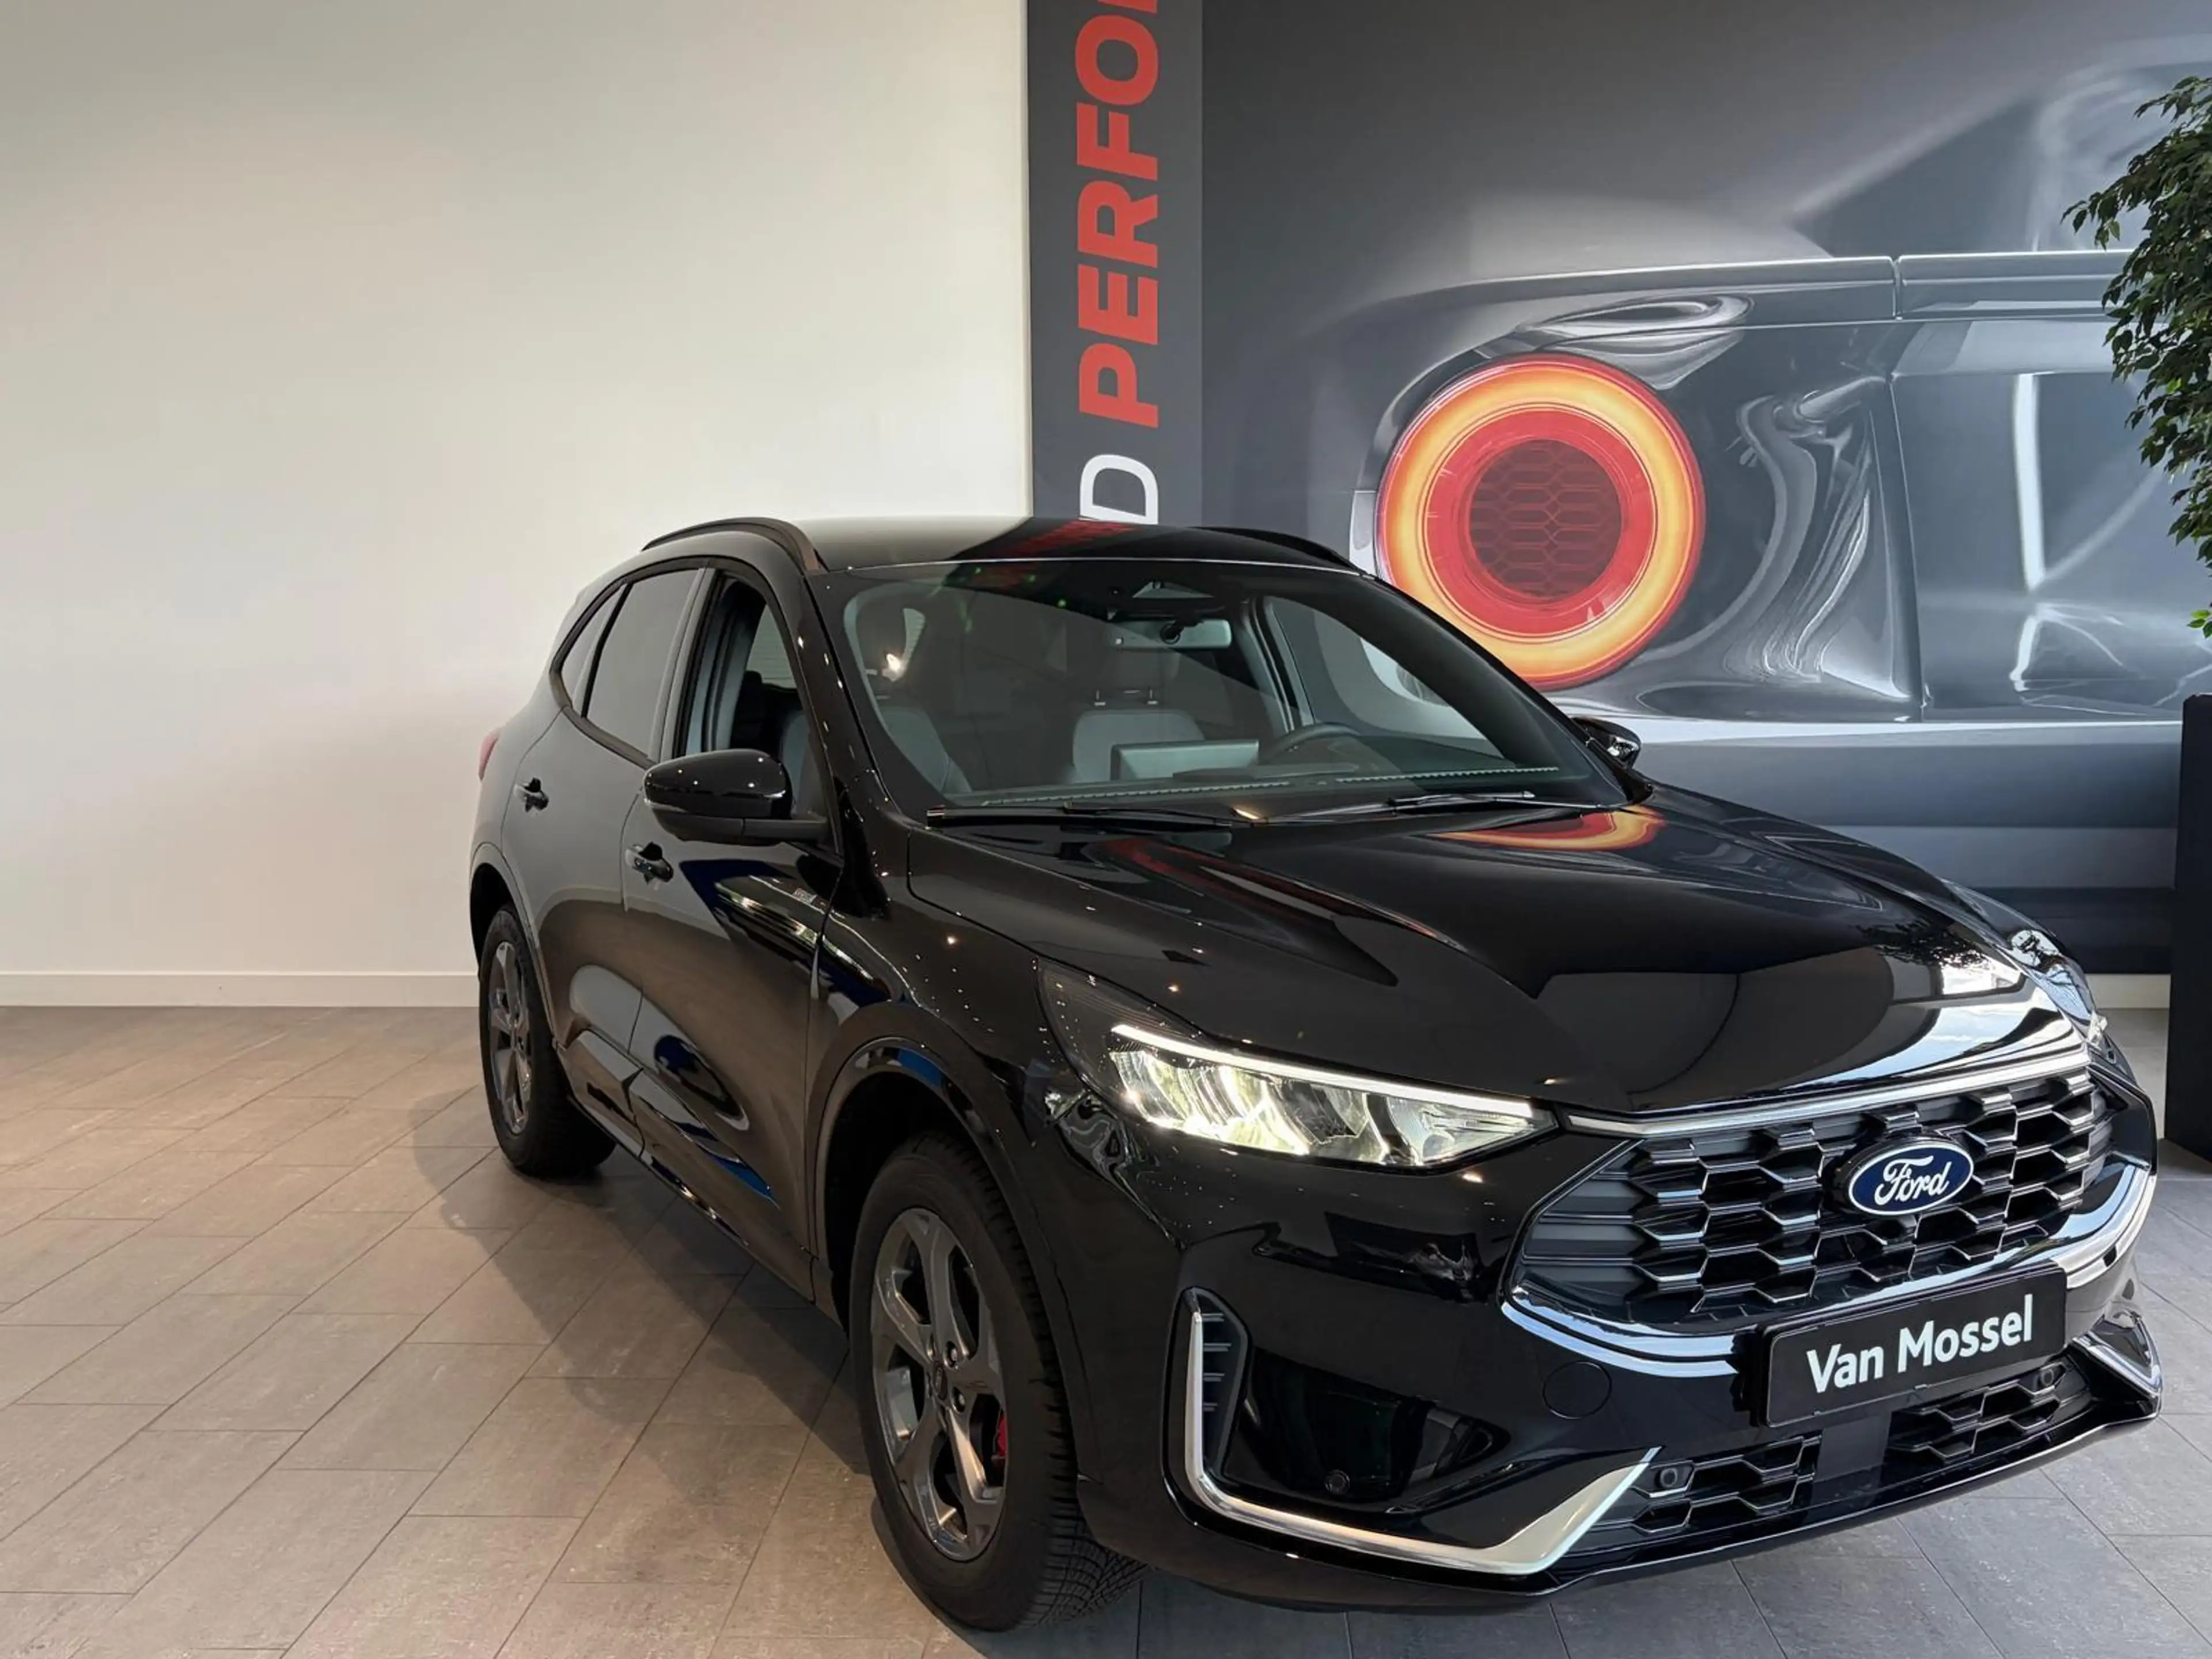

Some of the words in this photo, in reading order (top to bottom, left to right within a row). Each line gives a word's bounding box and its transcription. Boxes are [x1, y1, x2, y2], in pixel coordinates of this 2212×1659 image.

[1075, 0, 1158, 427] PERFO
[1874, 1156, 1952, 1206] Ford
[1806, 1343, 1884, 1393] Van
[1897, 1293, 2033, 1373] Mossel
